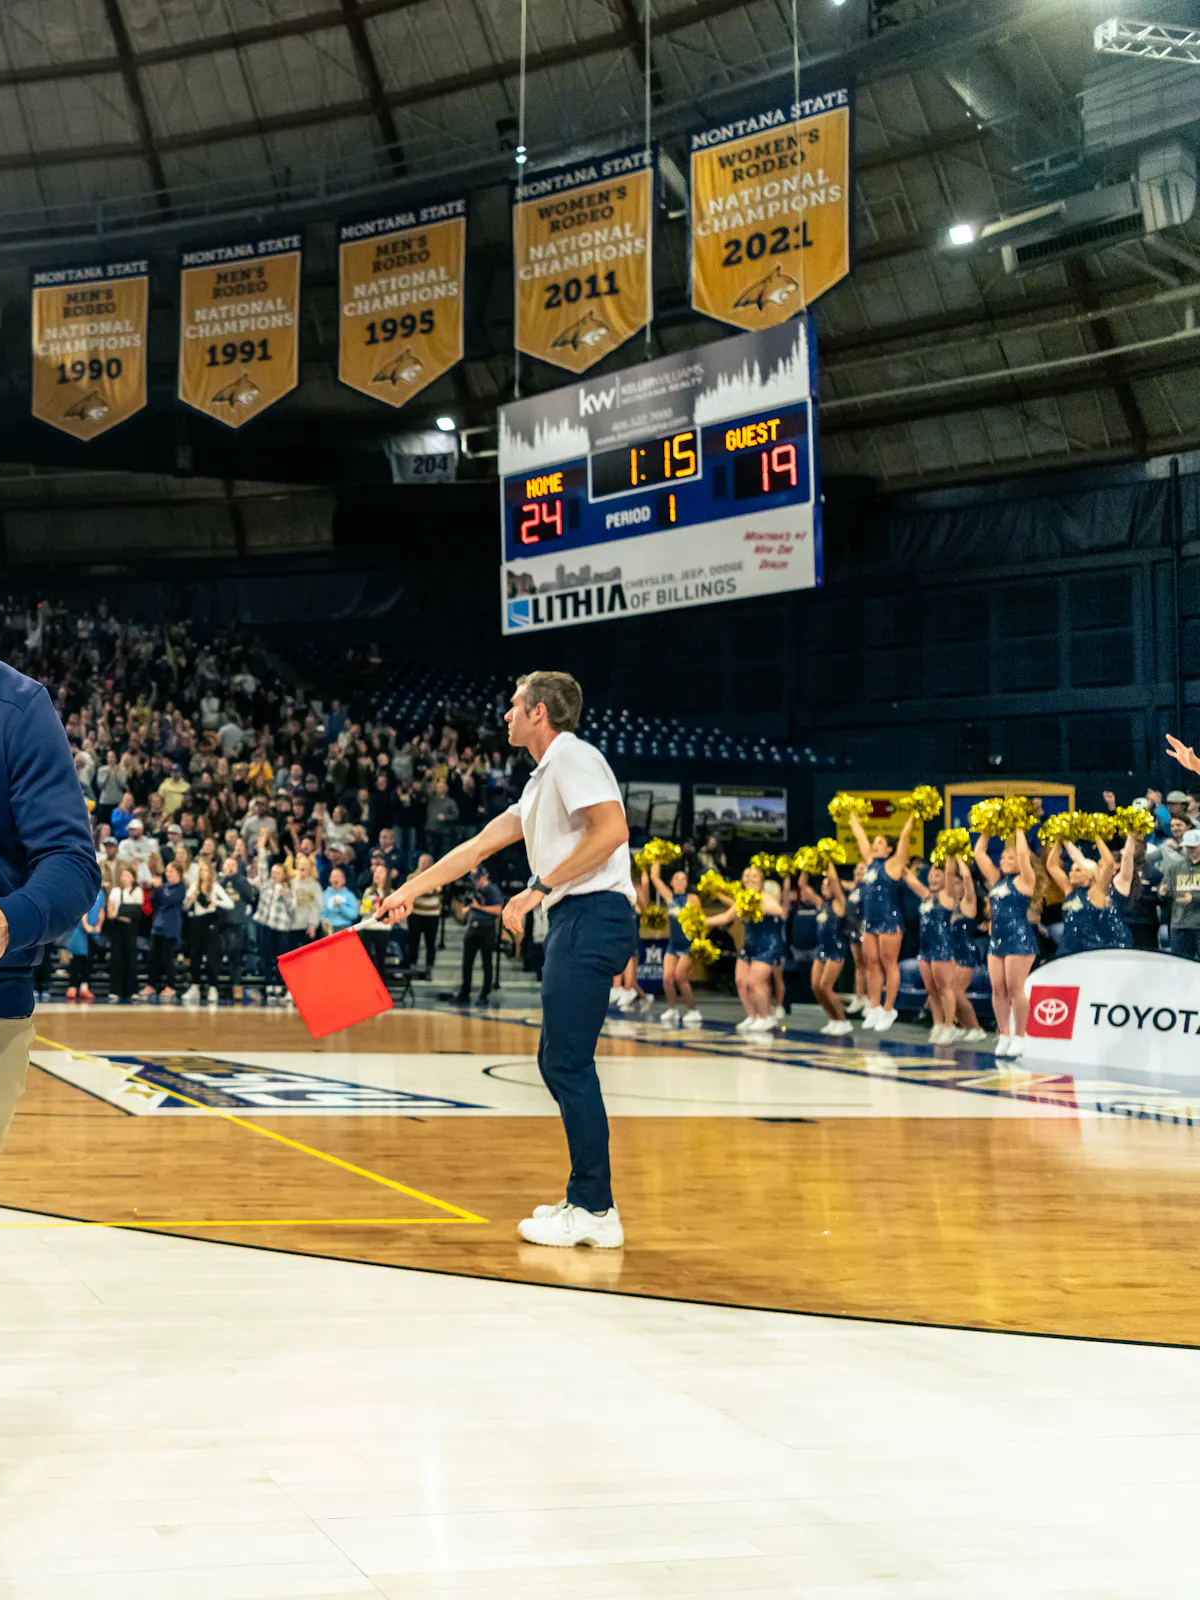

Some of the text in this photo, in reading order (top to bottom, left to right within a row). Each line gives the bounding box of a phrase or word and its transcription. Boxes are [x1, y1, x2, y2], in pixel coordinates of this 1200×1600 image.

[691, 88, 849, 150] MONTANA STATE
[719, 128, 820, 170] WOMEN'S
[516, 152, 654, 200] MONTANA STATE
[731, 151, 806, 184] RODEO
[537, 186, 628, 220] WOMEN'S
[708, 168, 830, 216] NATIONAL
[341, 199, 466, 241] MONTANA STATE
[549, 205, 615, 234] RODEO
[696, 185, 842, 237] CHAMPIONS
[182, 235, 302, 265] MONTANA STATE
[375, 235, 428, 258] MEN'S
[528, 223, 636, 261] NATIONAL
[722, 221, 814, 268] 2021
[34, 261, 148, 285] MONTANA STATE
[215, 265, 265, 284] MEN'S
[372, 249, 430, 274] RODEO
[519, 237, 648, 282] CHAMPIONS
[65, 288, 114, 304] MEN'S
[212, 280, 268, 299] RODEO
[343, 281, 459, 317] CHAMPIONS
[353, 266, 449, 299] NATIONAL
[544, 271, 620, 310] 2011
[63, 303, 116, 319] RODEO
[185, 312, 296, 340] CHAMPIONS
[194, 298, 286, 323] NATIONAL
[45, 320, 135, 341] NATIONAL
[365, 310, 436, 346] 1995
[36, 333, 142, 358] CHAMPIONS
[206, 338, 272, 367] 1991
[57, 358, 122, 384] 1990
[579, 387, 616, 418] kw
[725, 418, 781, 452] GUEST
[412, 456, 448, 475] 204
[629, 432, 697, 486] 1:15
[761, 443, 798, 492] 19
[526, 471, 564, 499] HOME
[521, 499, 563, 545] 24
[605, 505, 651, 529] PERIOD
[668, 494, 677, 523] 1
[532, 583, 628, 624] LITHIA
[630, 576, 738, 610] OF BILLINGS
[1090, 1002, 1200, 1035] TOYOT
